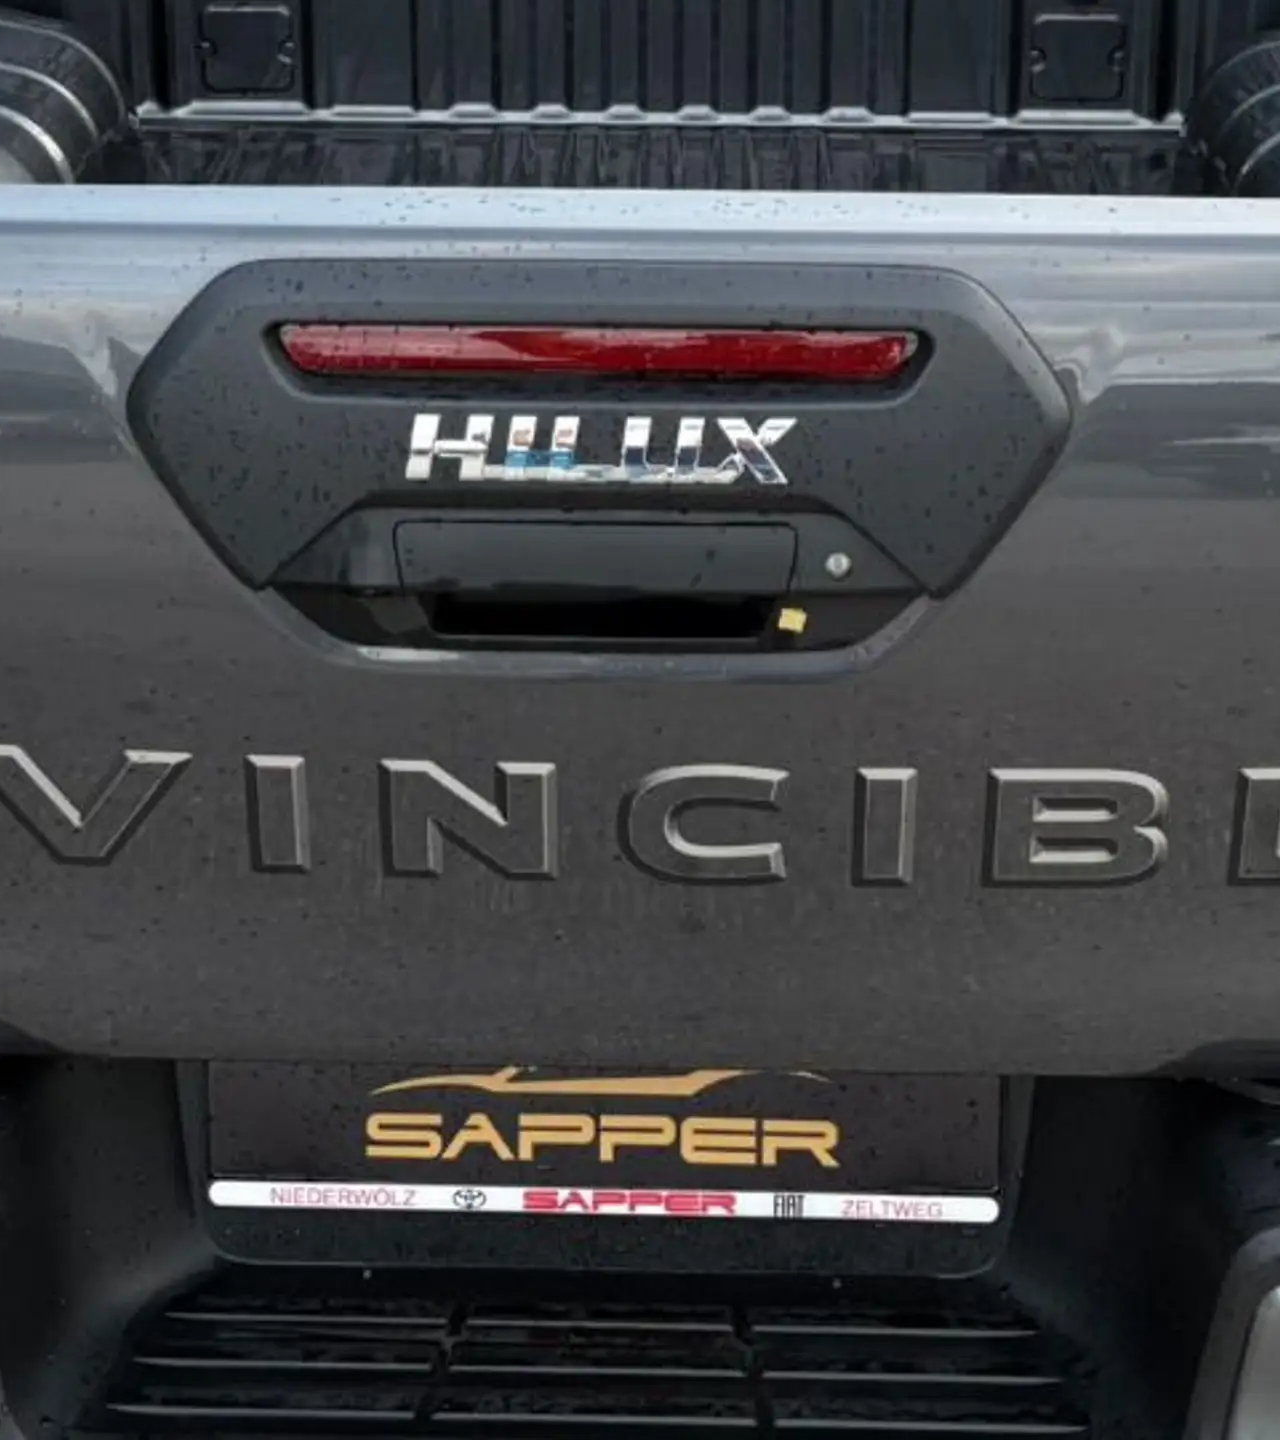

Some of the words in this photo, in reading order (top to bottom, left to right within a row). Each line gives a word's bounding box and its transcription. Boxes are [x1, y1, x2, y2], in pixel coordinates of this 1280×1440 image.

[404, 413, 797, 486] HILUX
[365, 1112, 840, 1168] SAPPER
[523, 1190, 735, 1217] SAPPER
[773, 1194, 805, 1218] FIAT
[841, 1200, 943, 1220] ZELTWEG
